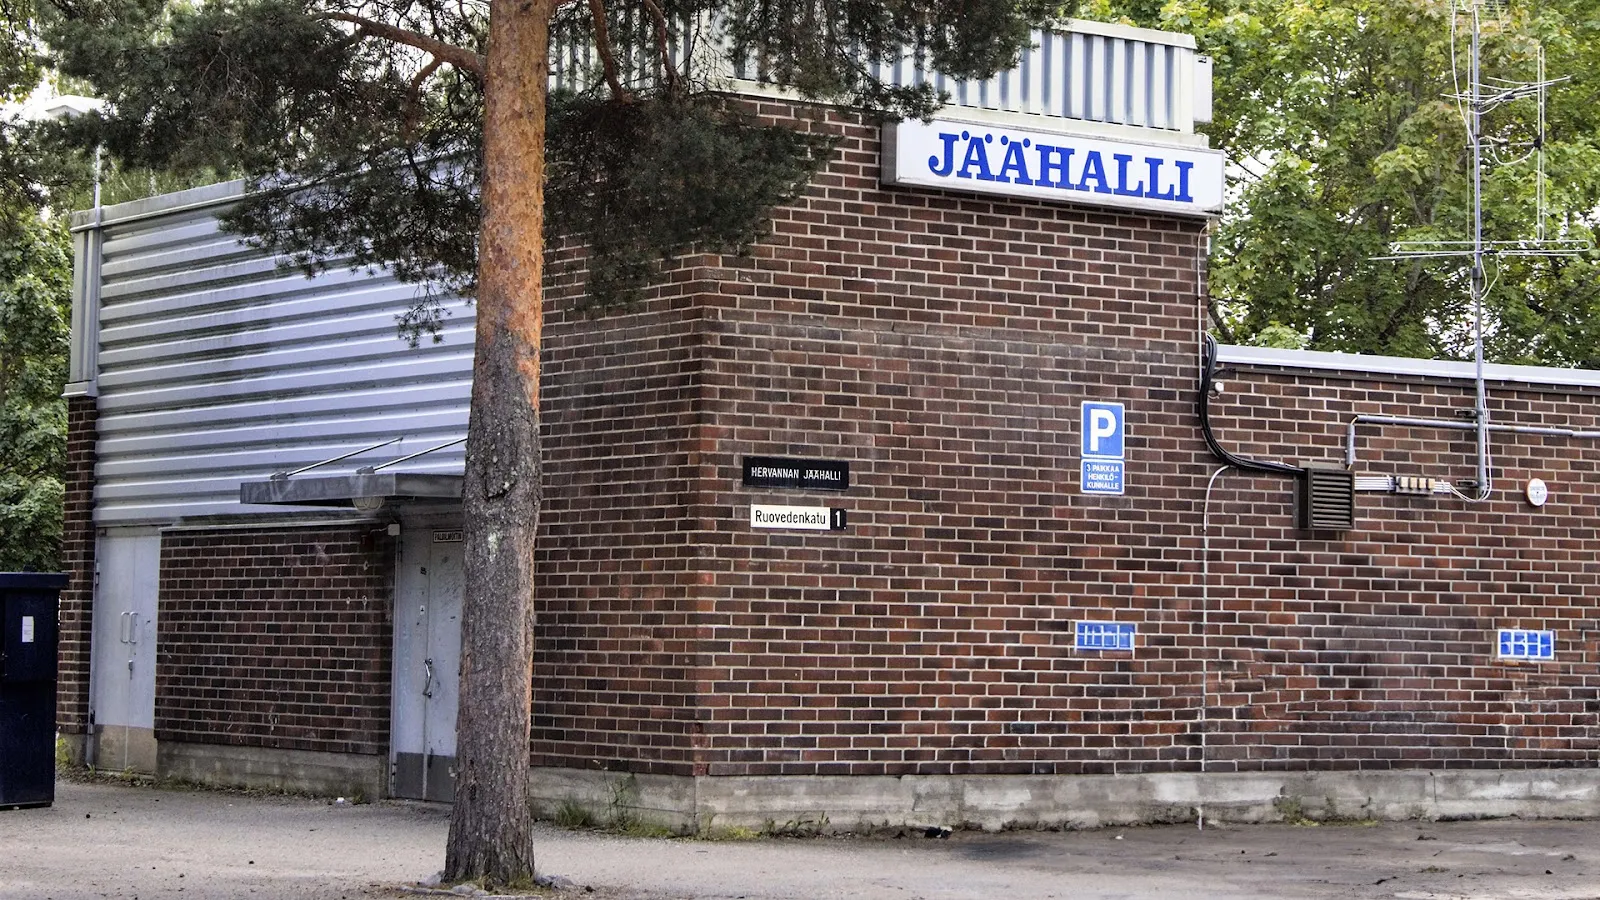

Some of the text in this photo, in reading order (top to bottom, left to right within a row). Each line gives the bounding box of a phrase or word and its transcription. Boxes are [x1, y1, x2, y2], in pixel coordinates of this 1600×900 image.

[928, 130, 1194, 203] JÄÄHALLI
[1090, 408, 1117, 452] P
[751, 466, 841, 481] HERVANNAN JÄÄHALLI
[1086, 463, 1120, 473] 3 PAIKKAA
[755, 509, 841, 527] Ruovedenkatu 1
